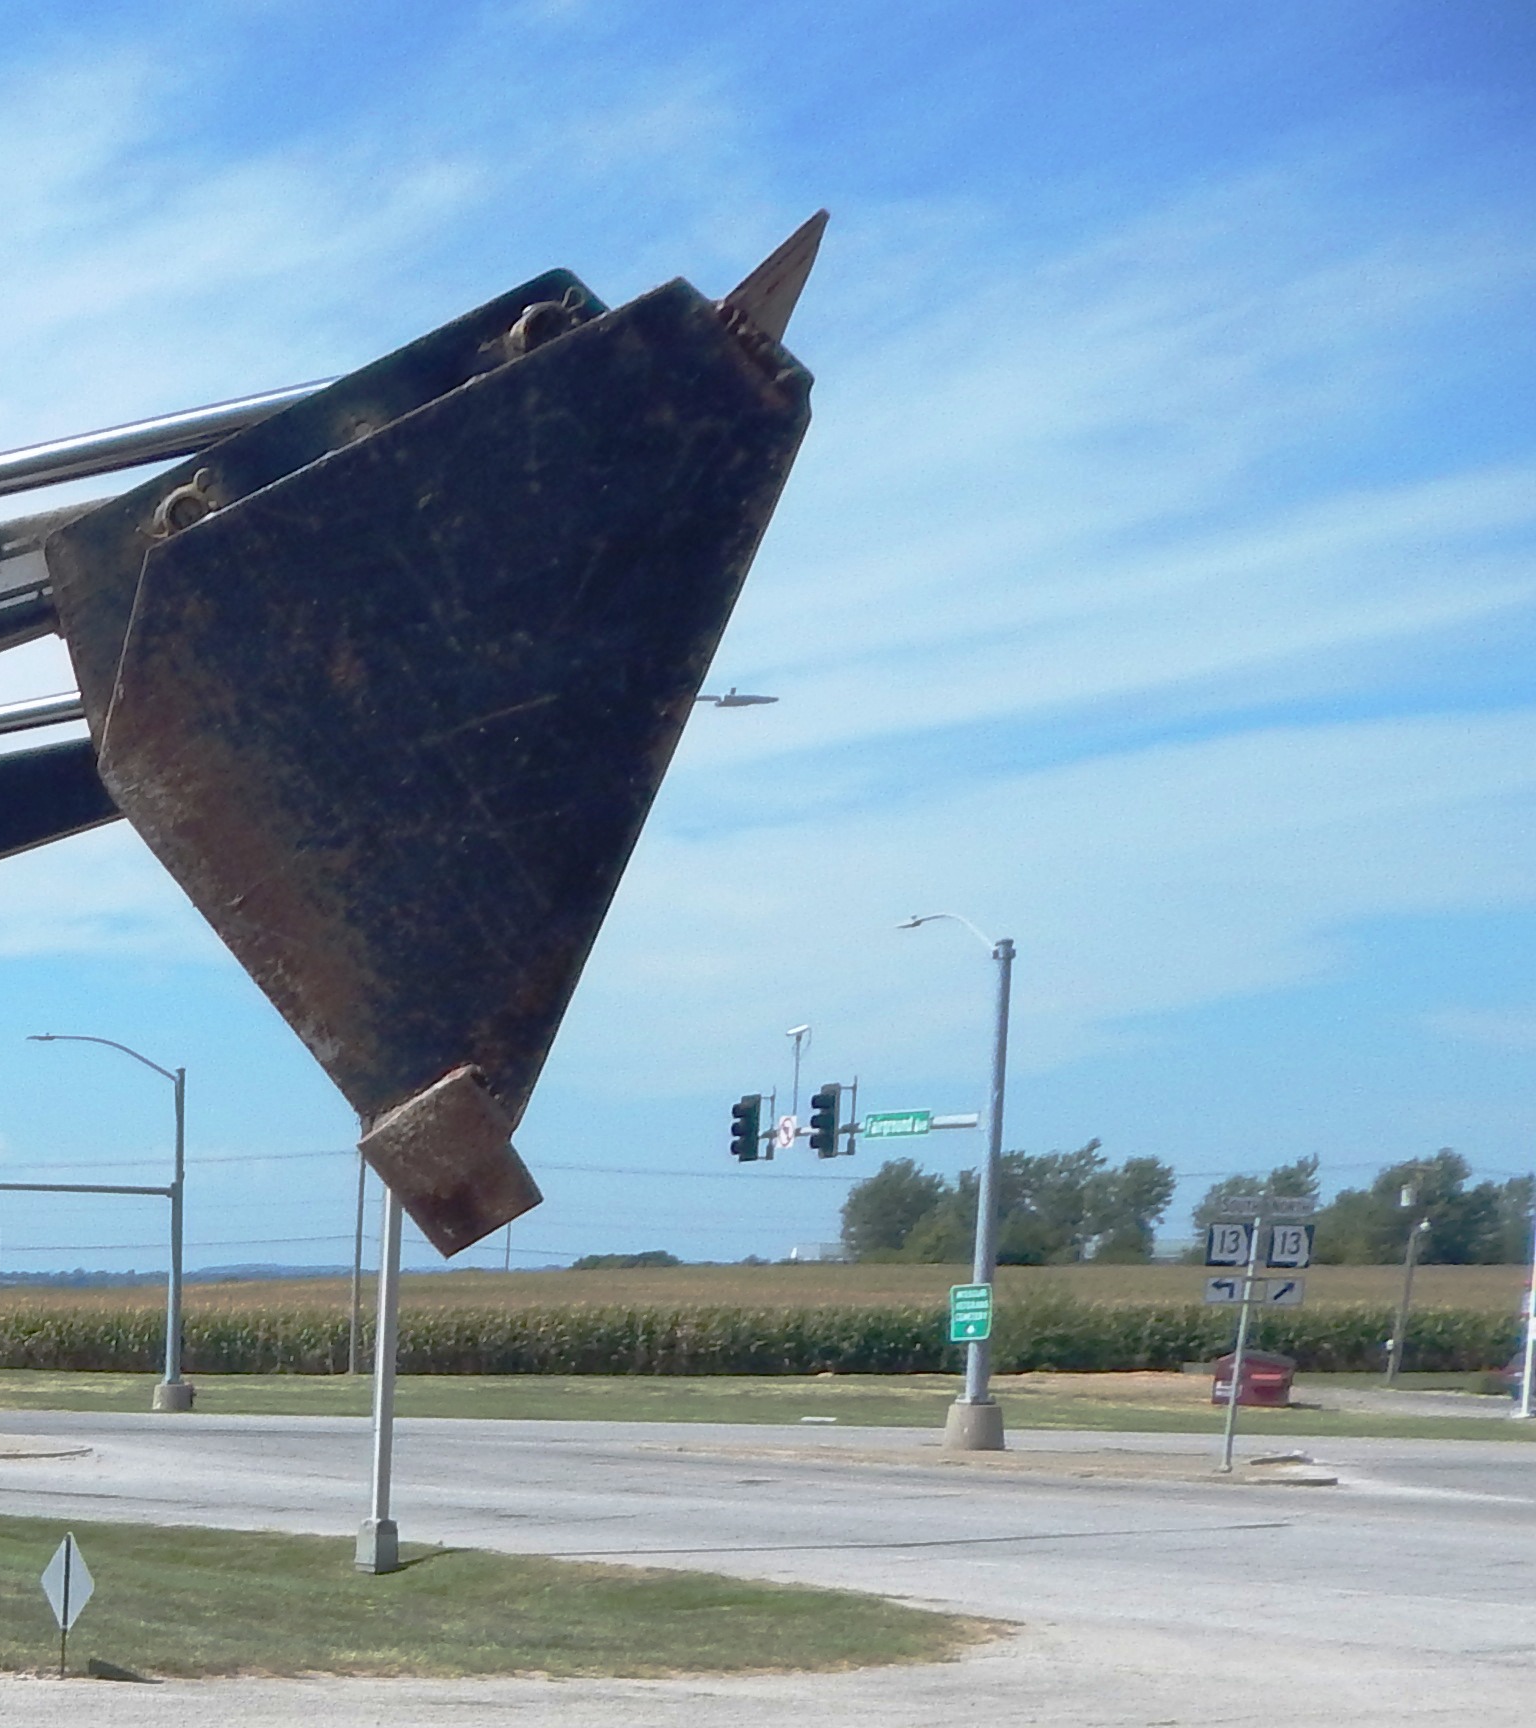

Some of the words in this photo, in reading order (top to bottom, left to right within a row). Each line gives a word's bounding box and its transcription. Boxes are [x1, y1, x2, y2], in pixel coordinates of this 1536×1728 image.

[1222, 1198, 1259, 1213] SOUTH
[1219, 1229, 1241, 1254] 13
[1280, 1231, 1302, 1255] 13
